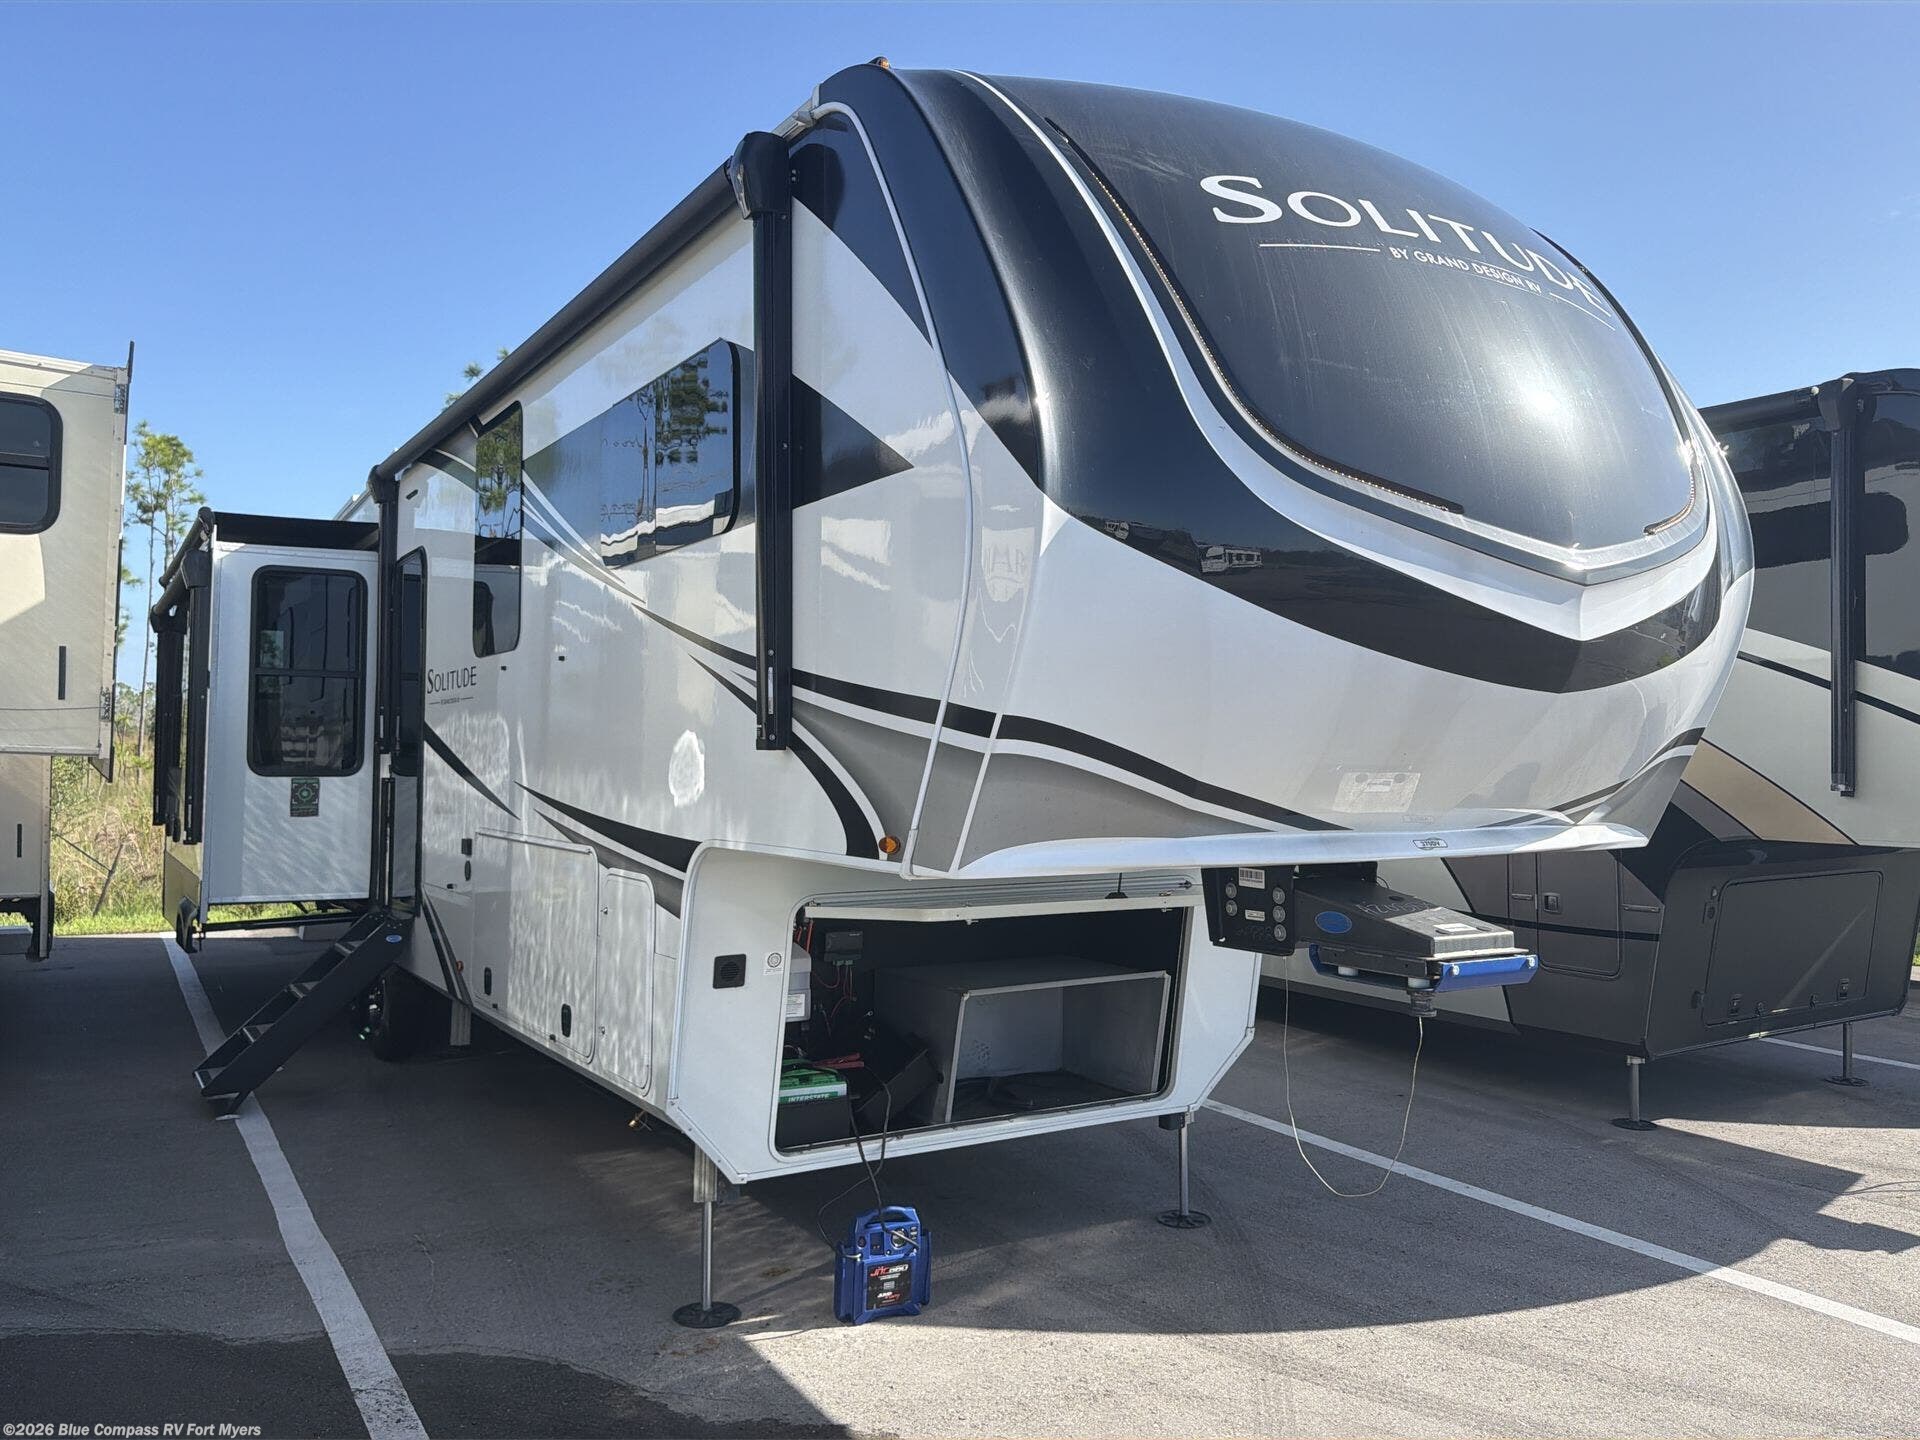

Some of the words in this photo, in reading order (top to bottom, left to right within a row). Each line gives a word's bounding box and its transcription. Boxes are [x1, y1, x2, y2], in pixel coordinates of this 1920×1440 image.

[1200, 175, 1612, 317] SOLITUDE
[1389, 246, 1409, 260] BY
[1413, 250, 1470, 271] GRAND
[1471, 262, 1525, 287] DESIGN
[427, 666, 477, 694] SOLITUDE
[788, 1093, 830, 1103] INTERSTATE
